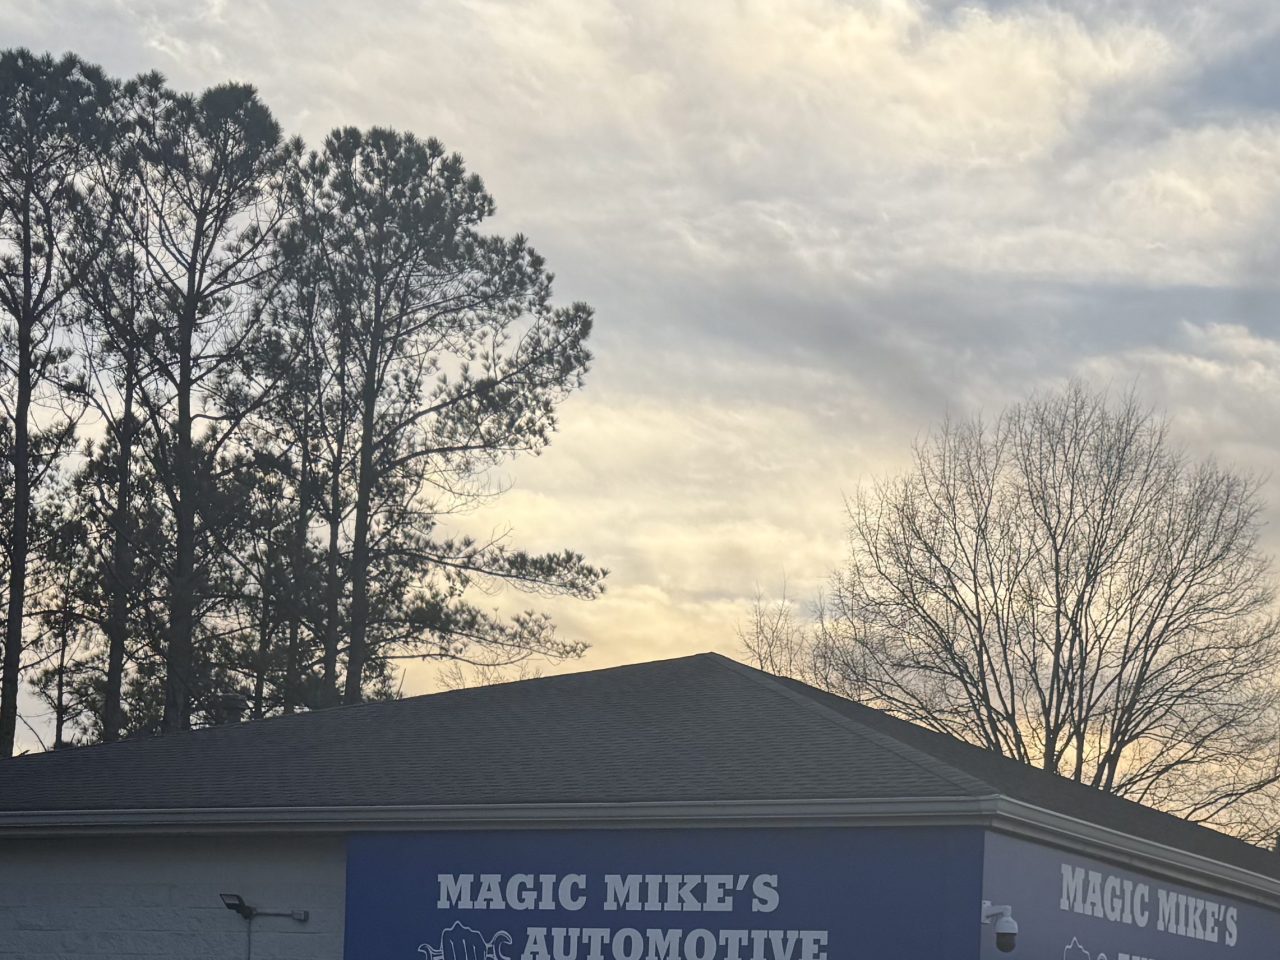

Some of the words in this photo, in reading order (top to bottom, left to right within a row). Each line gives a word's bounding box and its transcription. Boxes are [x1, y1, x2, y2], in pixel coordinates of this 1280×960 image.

[437, 873, 586, 909] MAGIC
[604, 874, 779, 912] MIKE'S
[1060, 863, 1149, 928] MAGIC
[1156, 889, 1238, 947] MIKE'S
